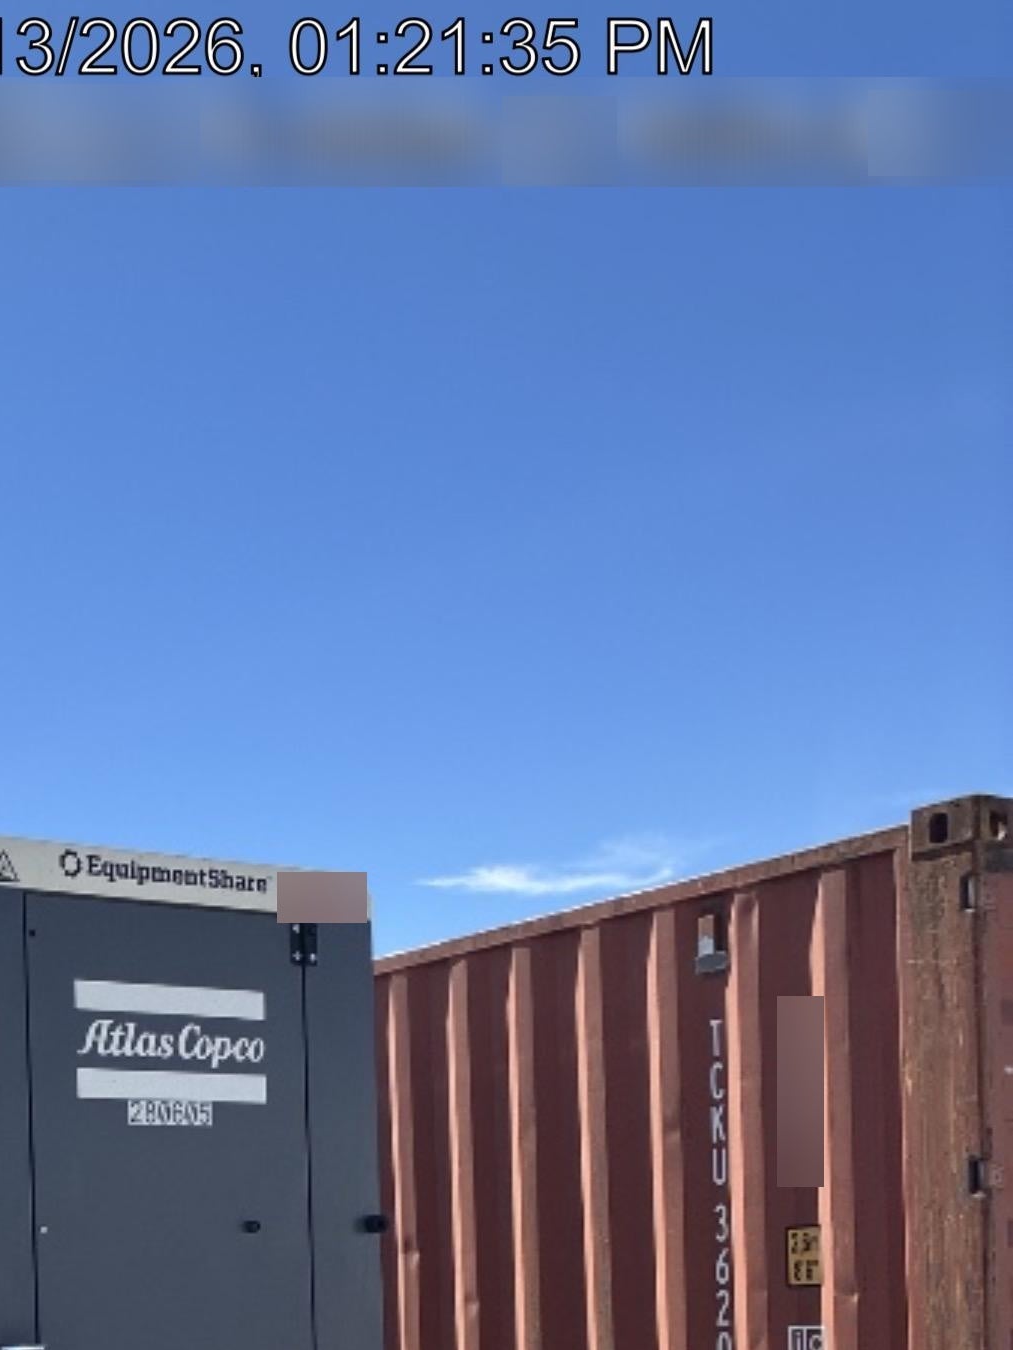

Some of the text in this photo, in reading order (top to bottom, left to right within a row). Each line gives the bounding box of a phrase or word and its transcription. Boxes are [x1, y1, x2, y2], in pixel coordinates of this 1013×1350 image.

[86, 854, 267, 894] EquipmentShare
[76, 1019, 265, 1069] Atlas Copco
[709, 1019, 726, 1186] TCKU
